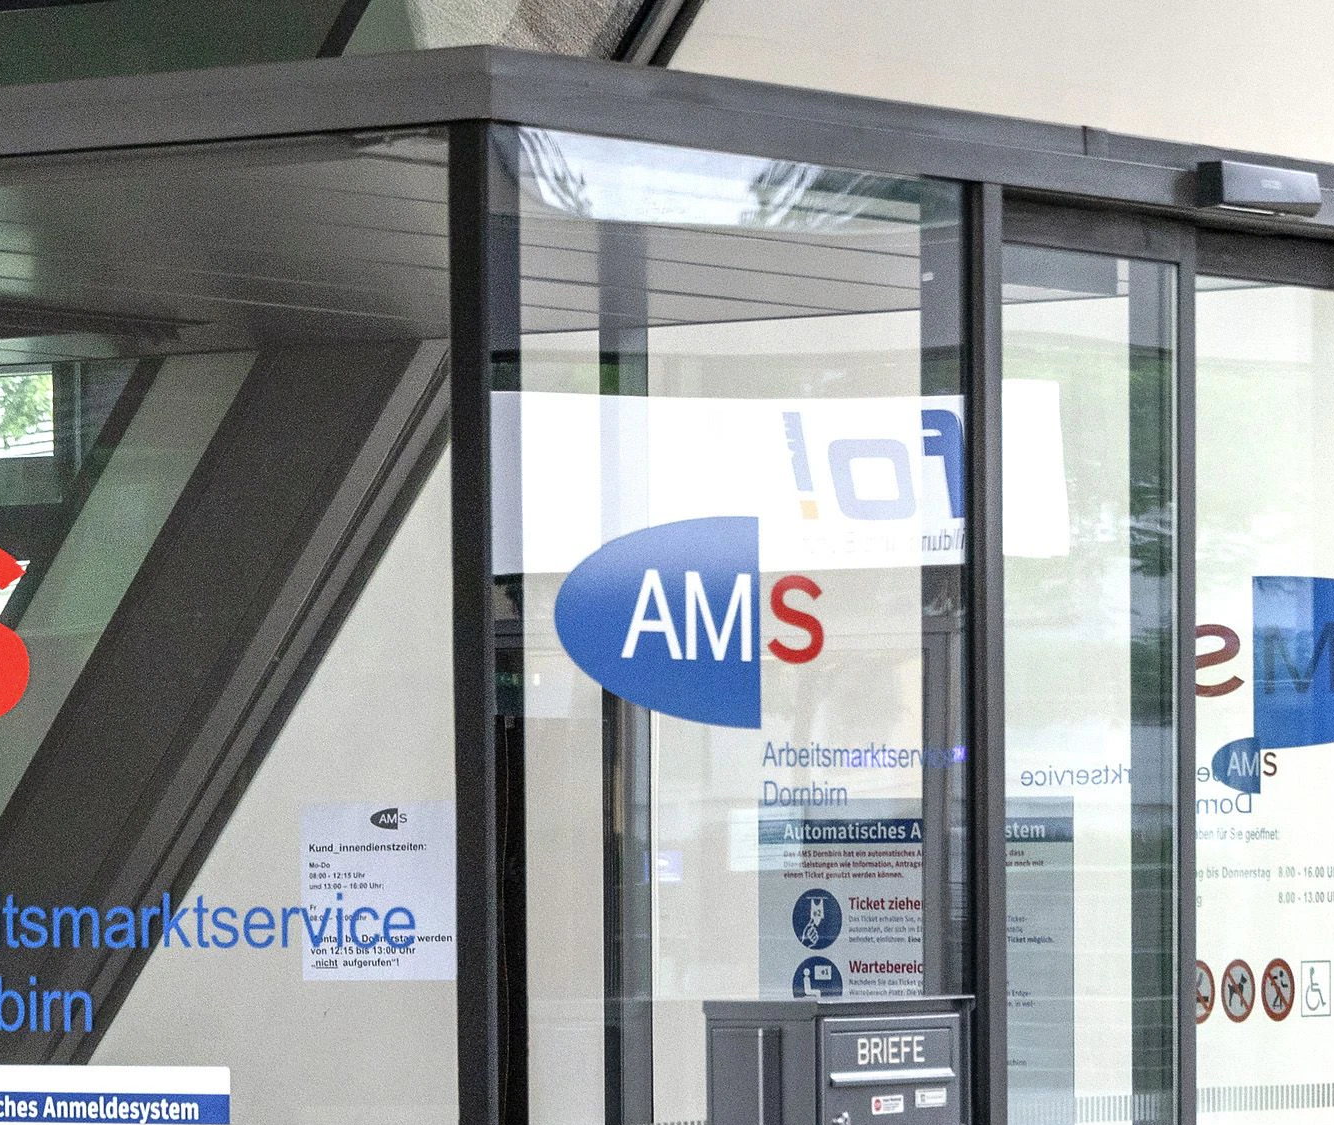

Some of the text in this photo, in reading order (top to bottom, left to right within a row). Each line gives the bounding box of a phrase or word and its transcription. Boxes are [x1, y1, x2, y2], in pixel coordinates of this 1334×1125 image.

[621, 570, 825, 665] AMS
[1227, 752, 1277, 776] AMS
[763, 781, 847, 806] Dornbirn
[379, 813, 407, 824] AMS
[784, 822, 906, 840] Automatisches
[309, 843, 427, 854] Kund_innendienstzeiten:
[1222, 866, 1271, 881] Donnerstag
[849, 897, 922, 910] Ticket ziehe
[417, 934, 452, 942] werden
[849, 960, 923, 974] Wartebereic
[857, 1036, 925, 1064] BRIEFE
[43, 1096, 200, 1124] Anmeldesystem
